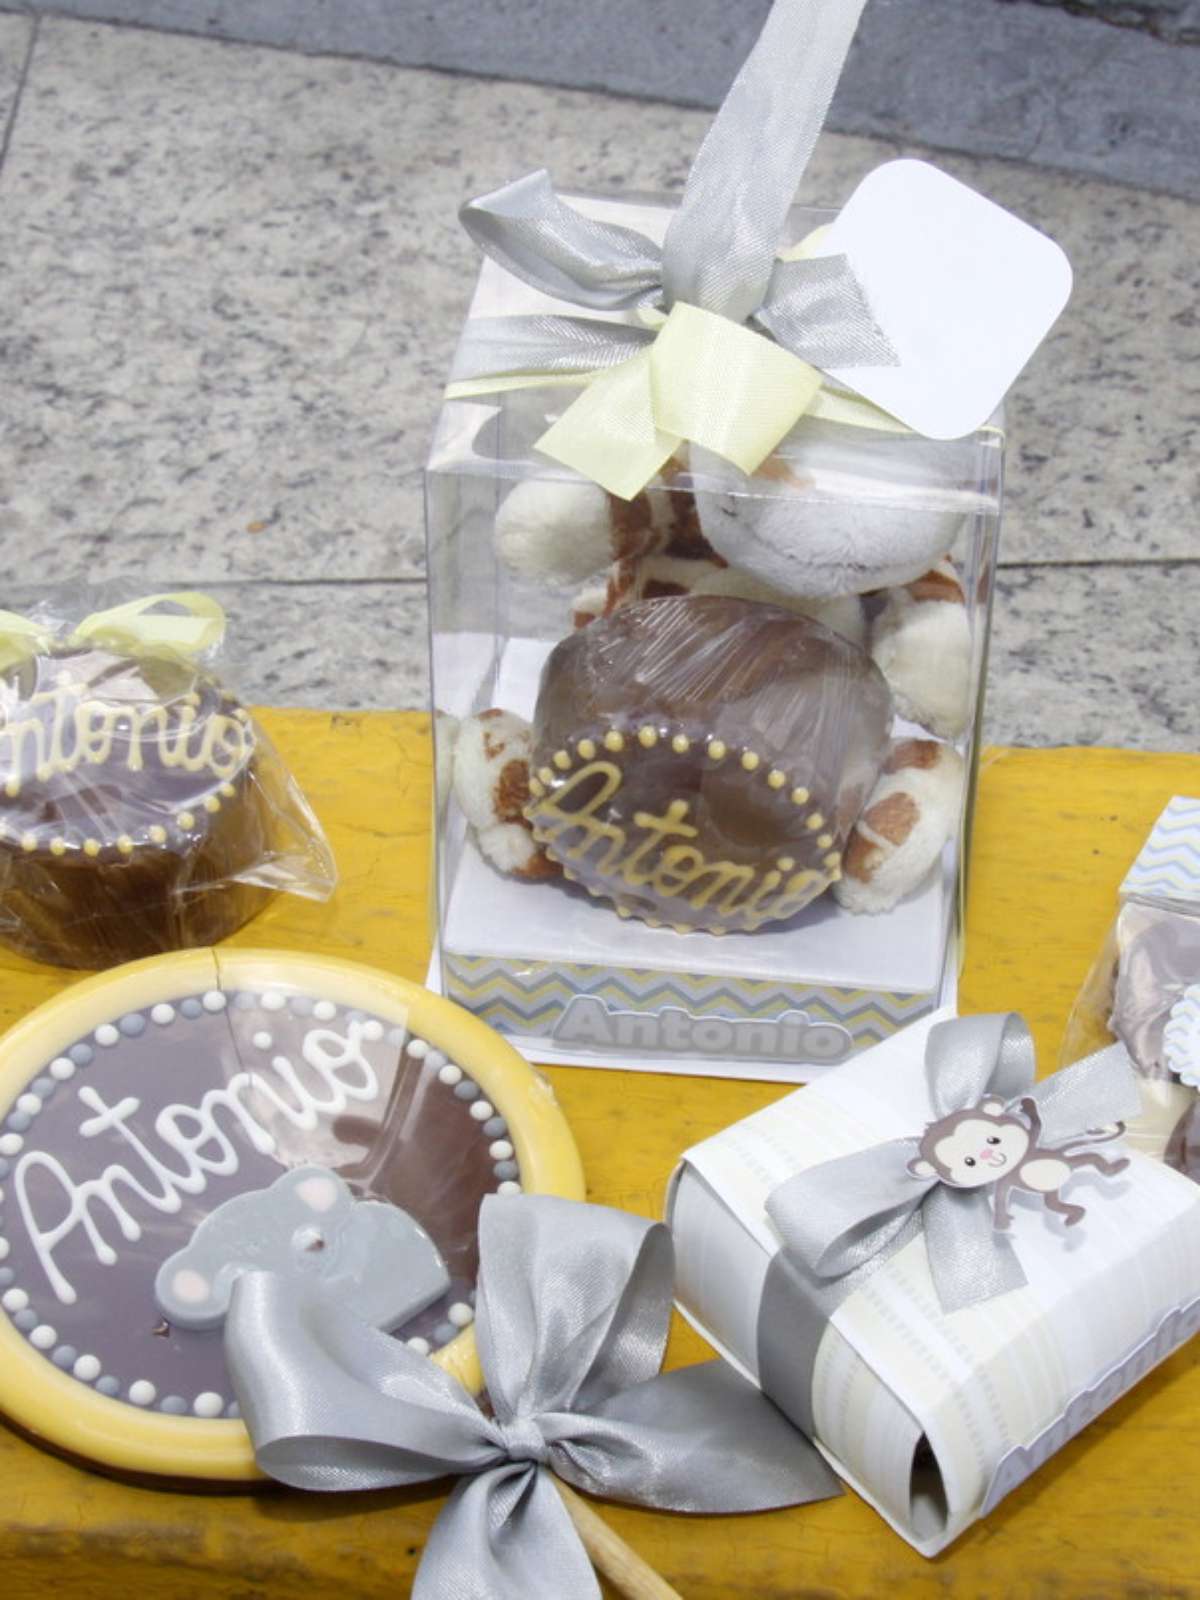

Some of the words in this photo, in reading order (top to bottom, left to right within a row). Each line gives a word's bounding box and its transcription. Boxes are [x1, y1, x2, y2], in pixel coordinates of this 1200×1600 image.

[532, 760, 832, 920] Antonio
[556, 998, 848, 1056] Antonio
[14, 1018, 378, 1304] Antonio
